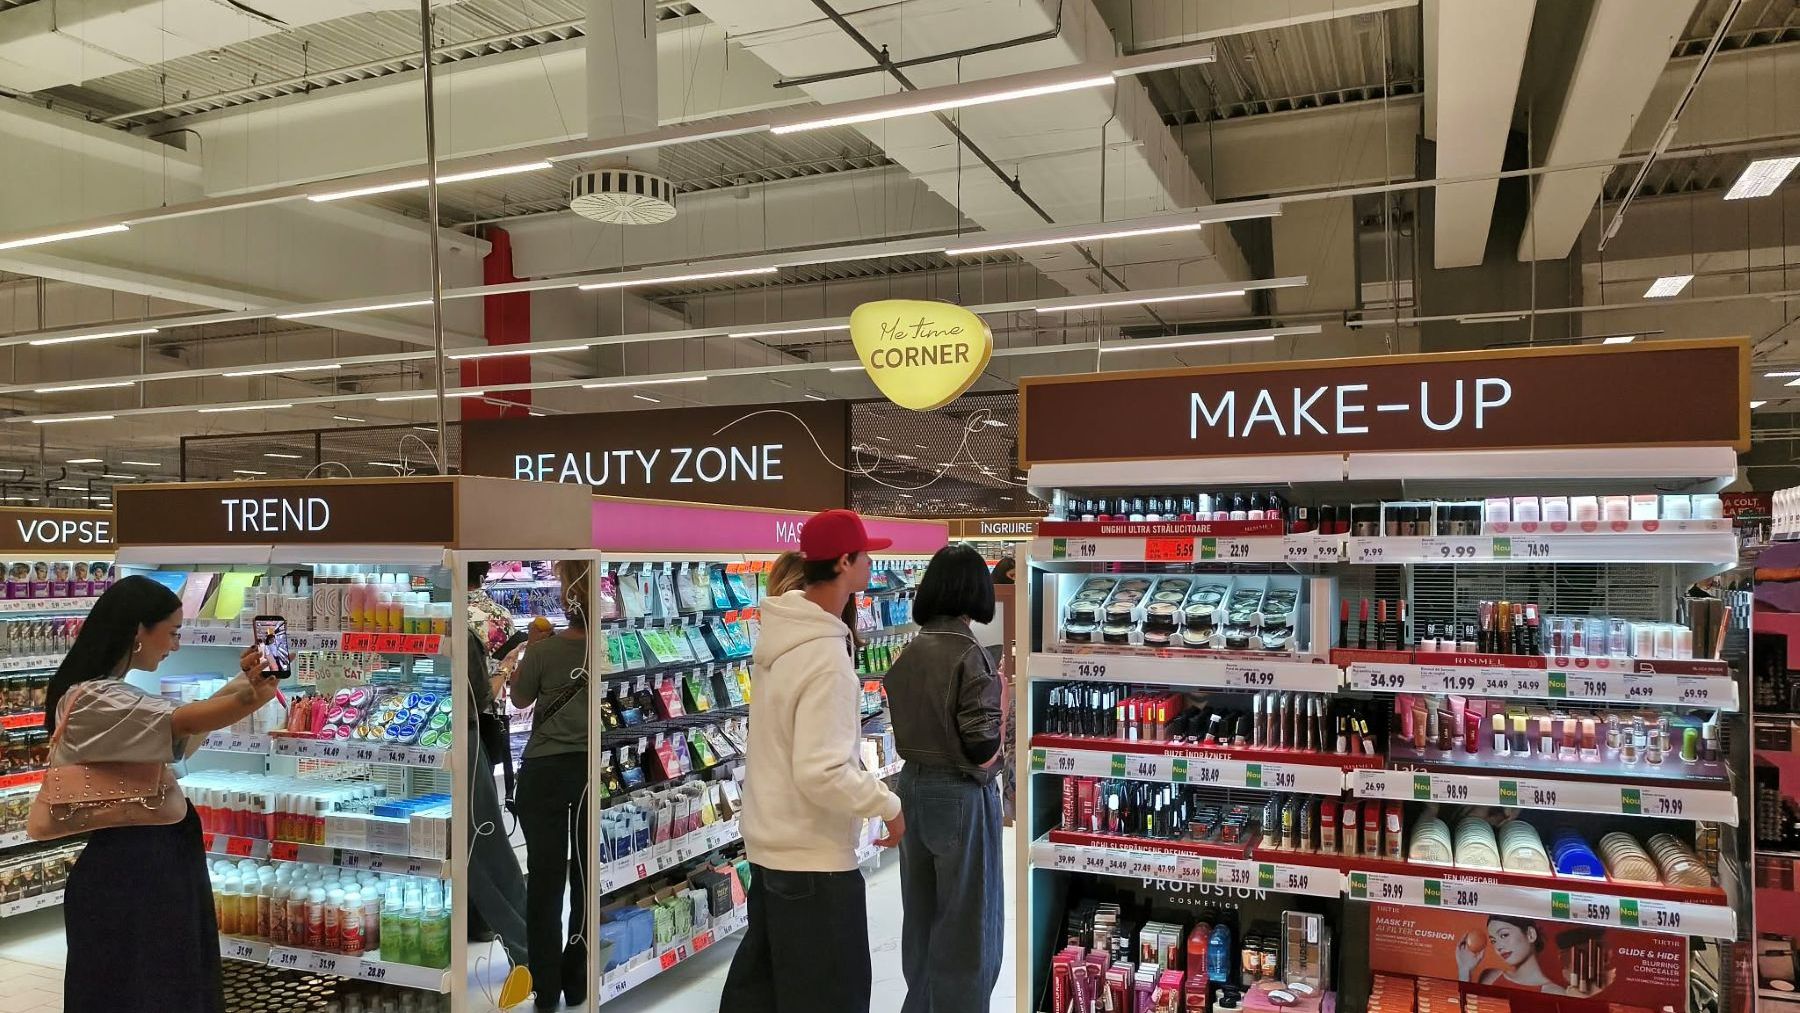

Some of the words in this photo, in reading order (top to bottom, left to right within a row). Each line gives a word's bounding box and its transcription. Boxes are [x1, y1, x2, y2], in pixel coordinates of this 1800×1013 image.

[881, 317, 908, 341] Me
[909, 316, 963, 339] time
[870, 343, 970, 369] CORNER
[1190, 378, 1512, 439] MAKE-UP
[515, 449, 660, 486] BEAUTY
[670, 444, 783, 483] ZONE
[221, 498, 330, 532] TREND
[17, 519, 113, 543] VOPSE
[980, 521, 1033, 533] ÎNGRIJIRE
[1101, 525, 1126, 534] UNGHII
[1128, 525, 1151, 534] ULTRA
[1152, 523, 1211, 534] STRĂLUCITOARE
[1081, 544, 1096, 556] 11.99
[1231, 544, 1249, 557] 22.99
[1364, 548, 1383, 556] 9.99
[1441, 546, 1476, 557] 9.99
[1527, 543, 1549, 557] 74.99
[290, 638, 307, 647] 79.99
[320, 640, 337, 648] 59.99
[1455, 657, 1502, 665] RIMMEL
[1079, 665, 1106, 676] 14.99
[1244, 672, 1274, 684] 14.99
[1370, 674, 1405, 687] 34.99
[1443, 677, 1475, 689] 11.99
[1486, 680, 1508, 688] 34.49
[1518, 681, 1539, 689] 34.99
[1549, 680, 1566, 688] Nou
[1584, 682, 1607, 695] 79.99
[1630, 687, 1653, 695] 64.99
[1684, 689, 1707, 698] 69.99
[323, 747, 339, 756] 14.49
[389, 752, 405, 761] 14.19
[418, 755, 435, 764] 14.19
[1059, 757, 1075, 770] 19.99
[1138, 763, 1156, 776] 44.49
[1201, 768, 1219, 782] 38.49
[1276, 772, 1295, 787] 34.99
[1365, 782, 1385, 791] 26.99
[1414, 783, 1430, 791] Nou
[1447, 784, 1467, 799] 98.99
[1500, 788, 1517, 796] Nou
[1534, 790, 1556, 805] 84.99
[1622, 796, 1640, 804] Nou
[1659, 799, 1682, 814] 79.99
[1058, 855, 1075, 864] 39.99
[1086, 858, 1104, 866] 34.49
[1109, 860, 1127, 869] 34.49
[1133, 863, 1150, 872] 27.49
[1157, 865, 1175, 873] 47.99
[1183, 867, 1200, 876] 35.49
[1202, 866, 1216, 874] Nou
[1231, 869, 1250, 884] 33.99
[1259, 871, 1273, 879] Nou
[1443, 873, 1458, 881] TEN
[1289, 874, 1309, 889] 55.49
[1351, 881, 1367, 889] Nou
[1143, 878, 1267, 900] PROFUSION
[1382, 883, 1403, 898] 59.99
[1424, 888, 1440, 896] Nou
[1170, 897, 1239, 910] COSMETICS
[1457, 891, 1478, 906] 28.49
[1552, 901, 1569, 909] Nou
[1587, 904, 1610, 919] 55.99
[1376, 917, 1400, 926] MASK
[1657, 911, 1680, 927] 37.49
[1415, 930, 1455, 940] CUSHION
[236, 946, 252, 956] 31.99
[1618, 947, 1646, 957] GLIDE
[1657, 952, 1680, 960] HIDE
[280, 954, 297, 964] 31.99
[319, 959, 335, 969] 31.99
[1633, 965, 1680, 976] CONCEALER
[1642, 960, 1680, 970] BLURRING
[367, 967, 385, 978] 28.89
